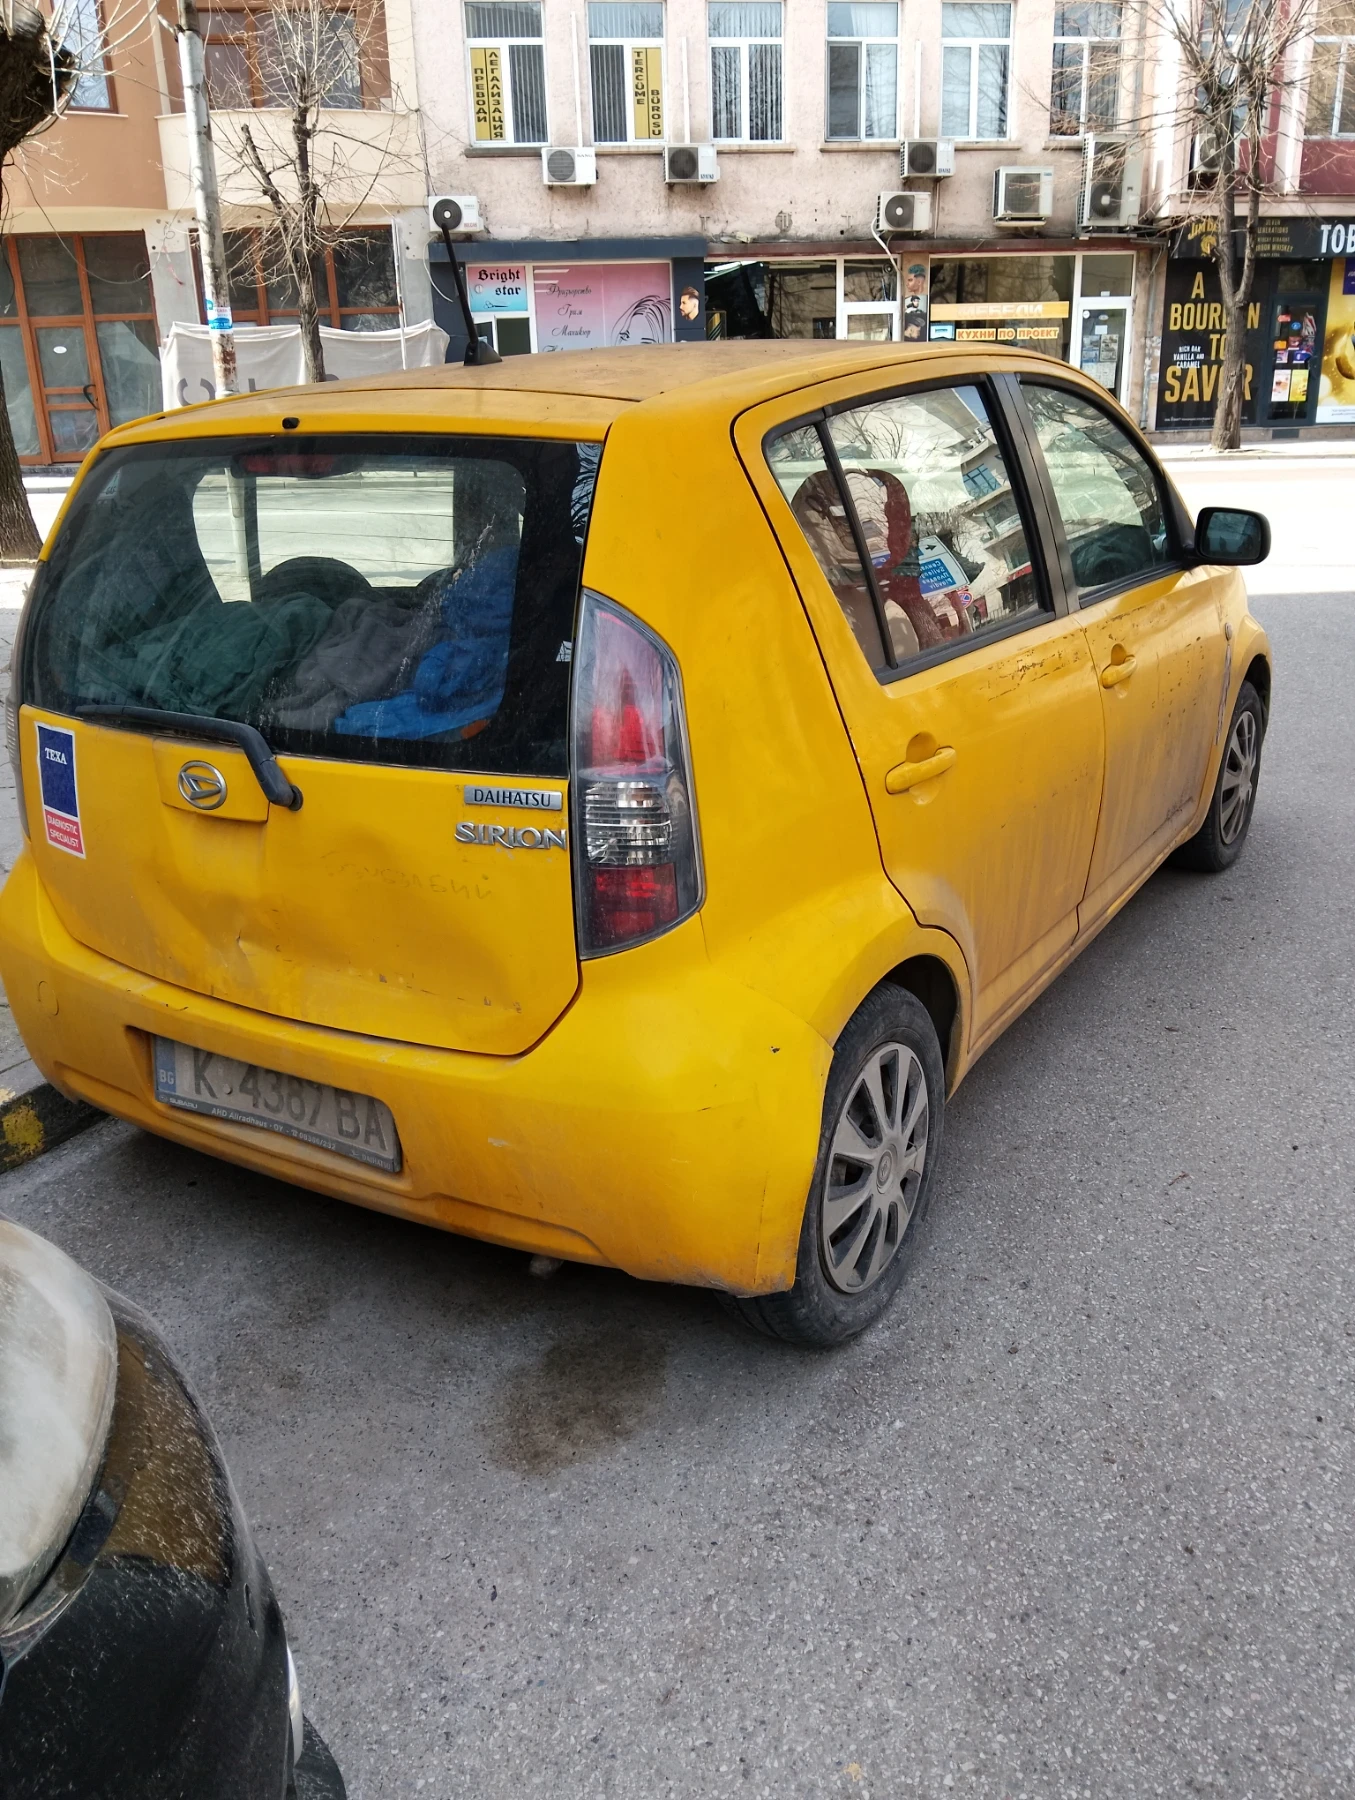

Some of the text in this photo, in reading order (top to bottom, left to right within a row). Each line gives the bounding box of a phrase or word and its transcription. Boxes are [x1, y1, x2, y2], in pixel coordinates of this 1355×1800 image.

[634, 51, 645, 104] TERCÜME
[474, 68, 487, 122] ПРЕВОДИ
[488, 51, 503, 138] ЛЕГАЛИЗАЦИЯ
[651, 90, 661, 135] BÜROSU
[478, 269, 521, 282] Bright
[495, 285, 521, 296] star
[1191, 271, 1205, 299] A
[557, 303, 582, 318] Грим
[1169, 302, 1261, 331] BOURN
[551, 325, 591, 338] Маникюр
[957, 330, 995, 339] КУХНИ
[999, 329, 1014, 339] ПО
[1018, 328, 1058, 338] ПРОЕКТ
[1173, 353, 1195, 361] VANILLA
[1176, 360, 1201, 369] CARAMEL
[45, 747, 67, 765] TEXA
[474, 788, 551, 807] DAIHATSU
[47, 815, 78, 835] DIAGNOSTIC
[49, 829, 79, 847] SPECIALIST
[454, 821, 567, 851] SIRION
[159, 1069, 174, 1085] BG
[169, 1097, 198, 1109] SUBARU
[193, 1047, 218, 1099] K
[334, 1088, 388, 1151] BA
[211, 1107, 227, 1117] AHD
[229, 1112, 267, 1128] Allradhaus
